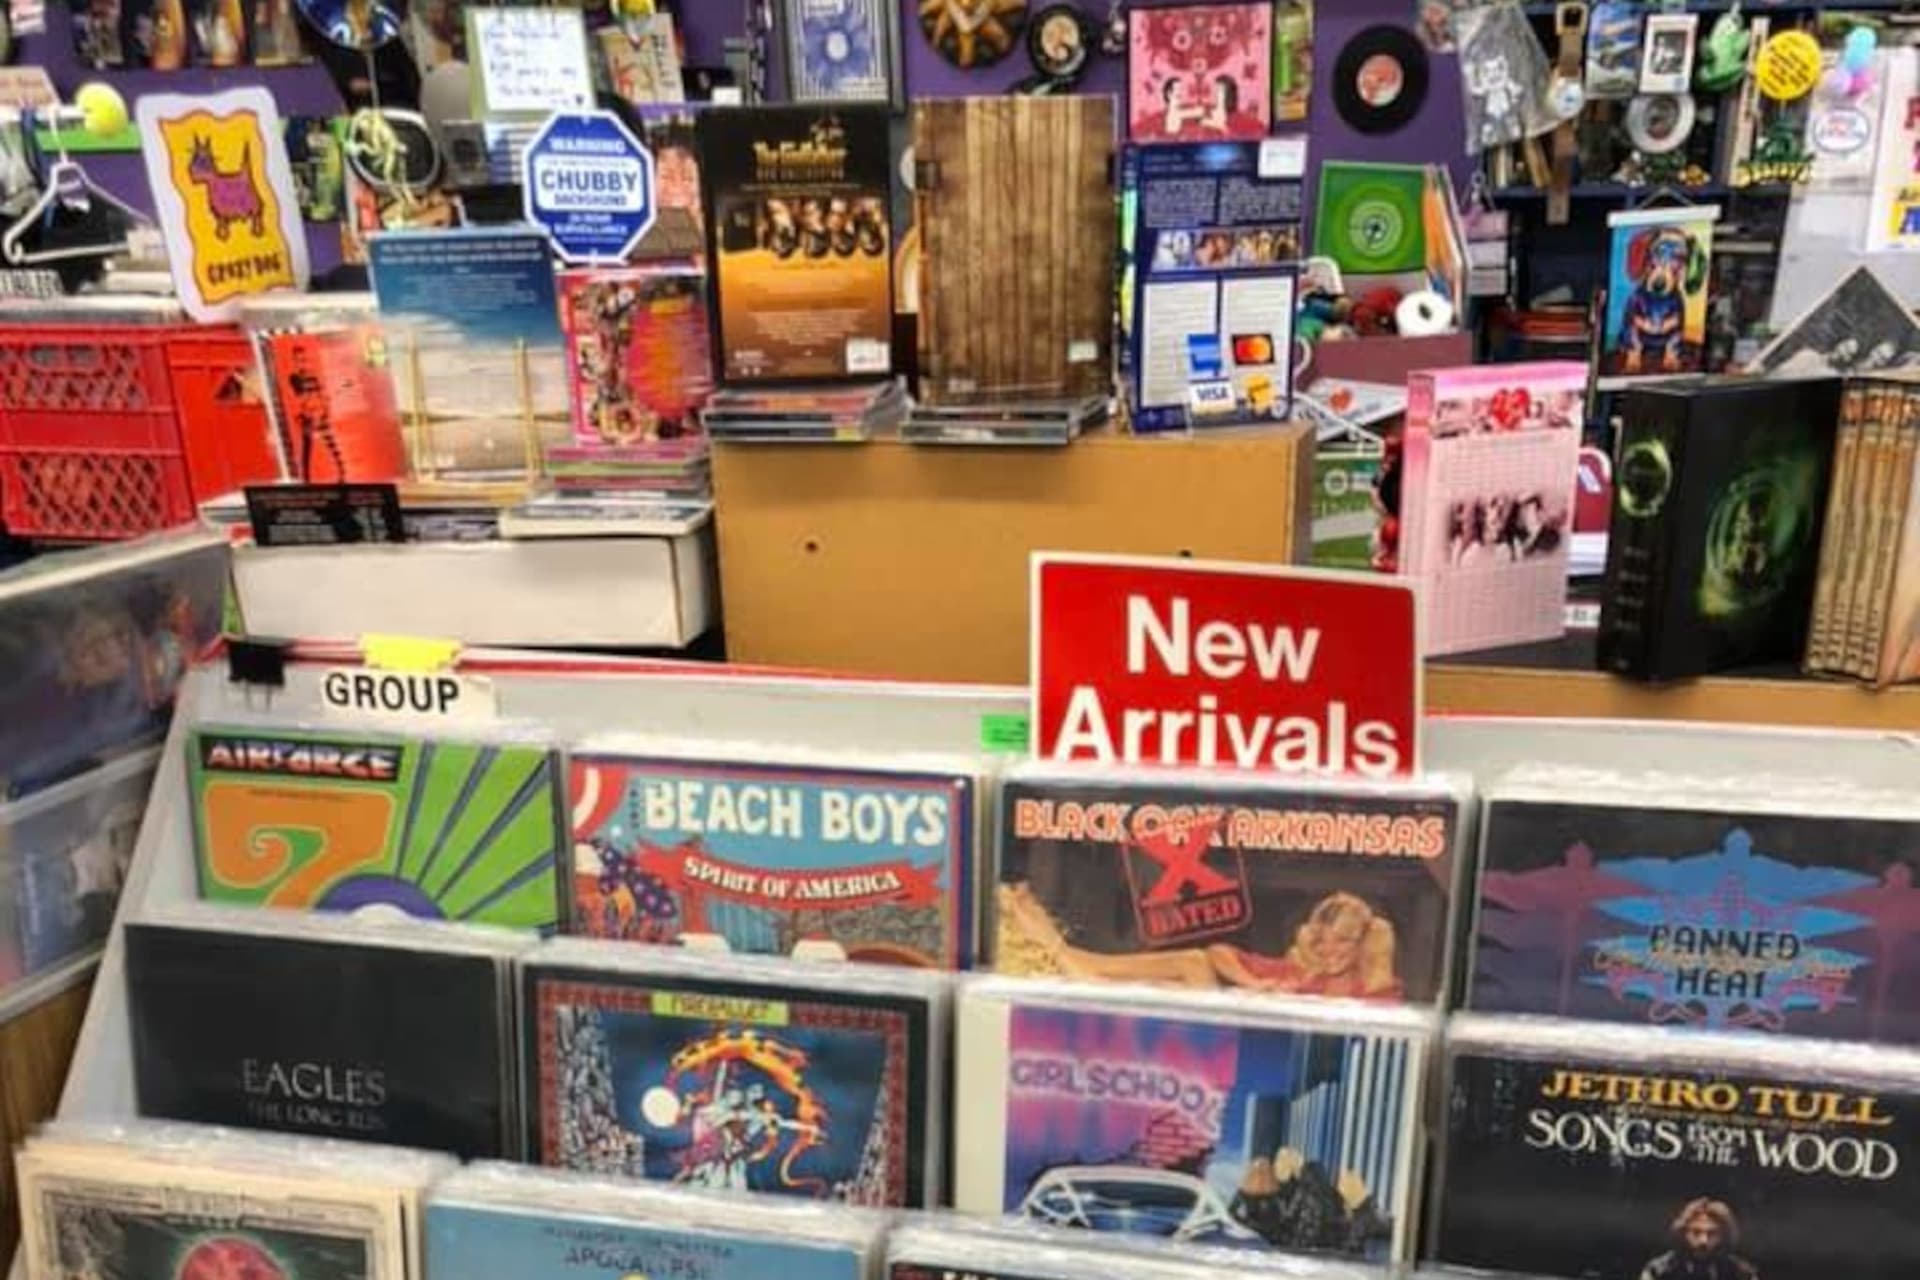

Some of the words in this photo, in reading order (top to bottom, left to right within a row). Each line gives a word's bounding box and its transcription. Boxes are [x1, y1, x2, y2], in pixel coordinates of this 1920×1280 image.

[550, 138, 626, 152] WARNING
[541, 170, 637, 192] CHUBBY
[1196, 387, 1228, 400] VISA
[1127, 595, 1321, 682] New
[325, 672, 460, 713] GROUP
[1052, 686, 1399, 779] Arrivals
[642, 777, 801, 838] BEACH
[821, 789, 947, 847] BOYS
[1015, 800, 1127, 841] BLACK
[1227, 804, 1445, 857] ARKANSAS
[684, 856, 754, 893] SPIRIT
[761, 878, 790, 899] OF
[793, 870, 900, 900] AMERICA
[1149, 895, 1243, 935] RATED
[1675, 967, 1767, 998] HEAT
[242, 1058, 385, 1105] EAGLES
[1541, 1069, 1739, 1112] JETHRO
[1748, 1085, 1894, 1126] TULL
[1524, 1108, 1683, 1160] SONGS
[1685, 1121, 1748, 1147] FROM
[1752, 1129, 1899, 1181] WOOD
